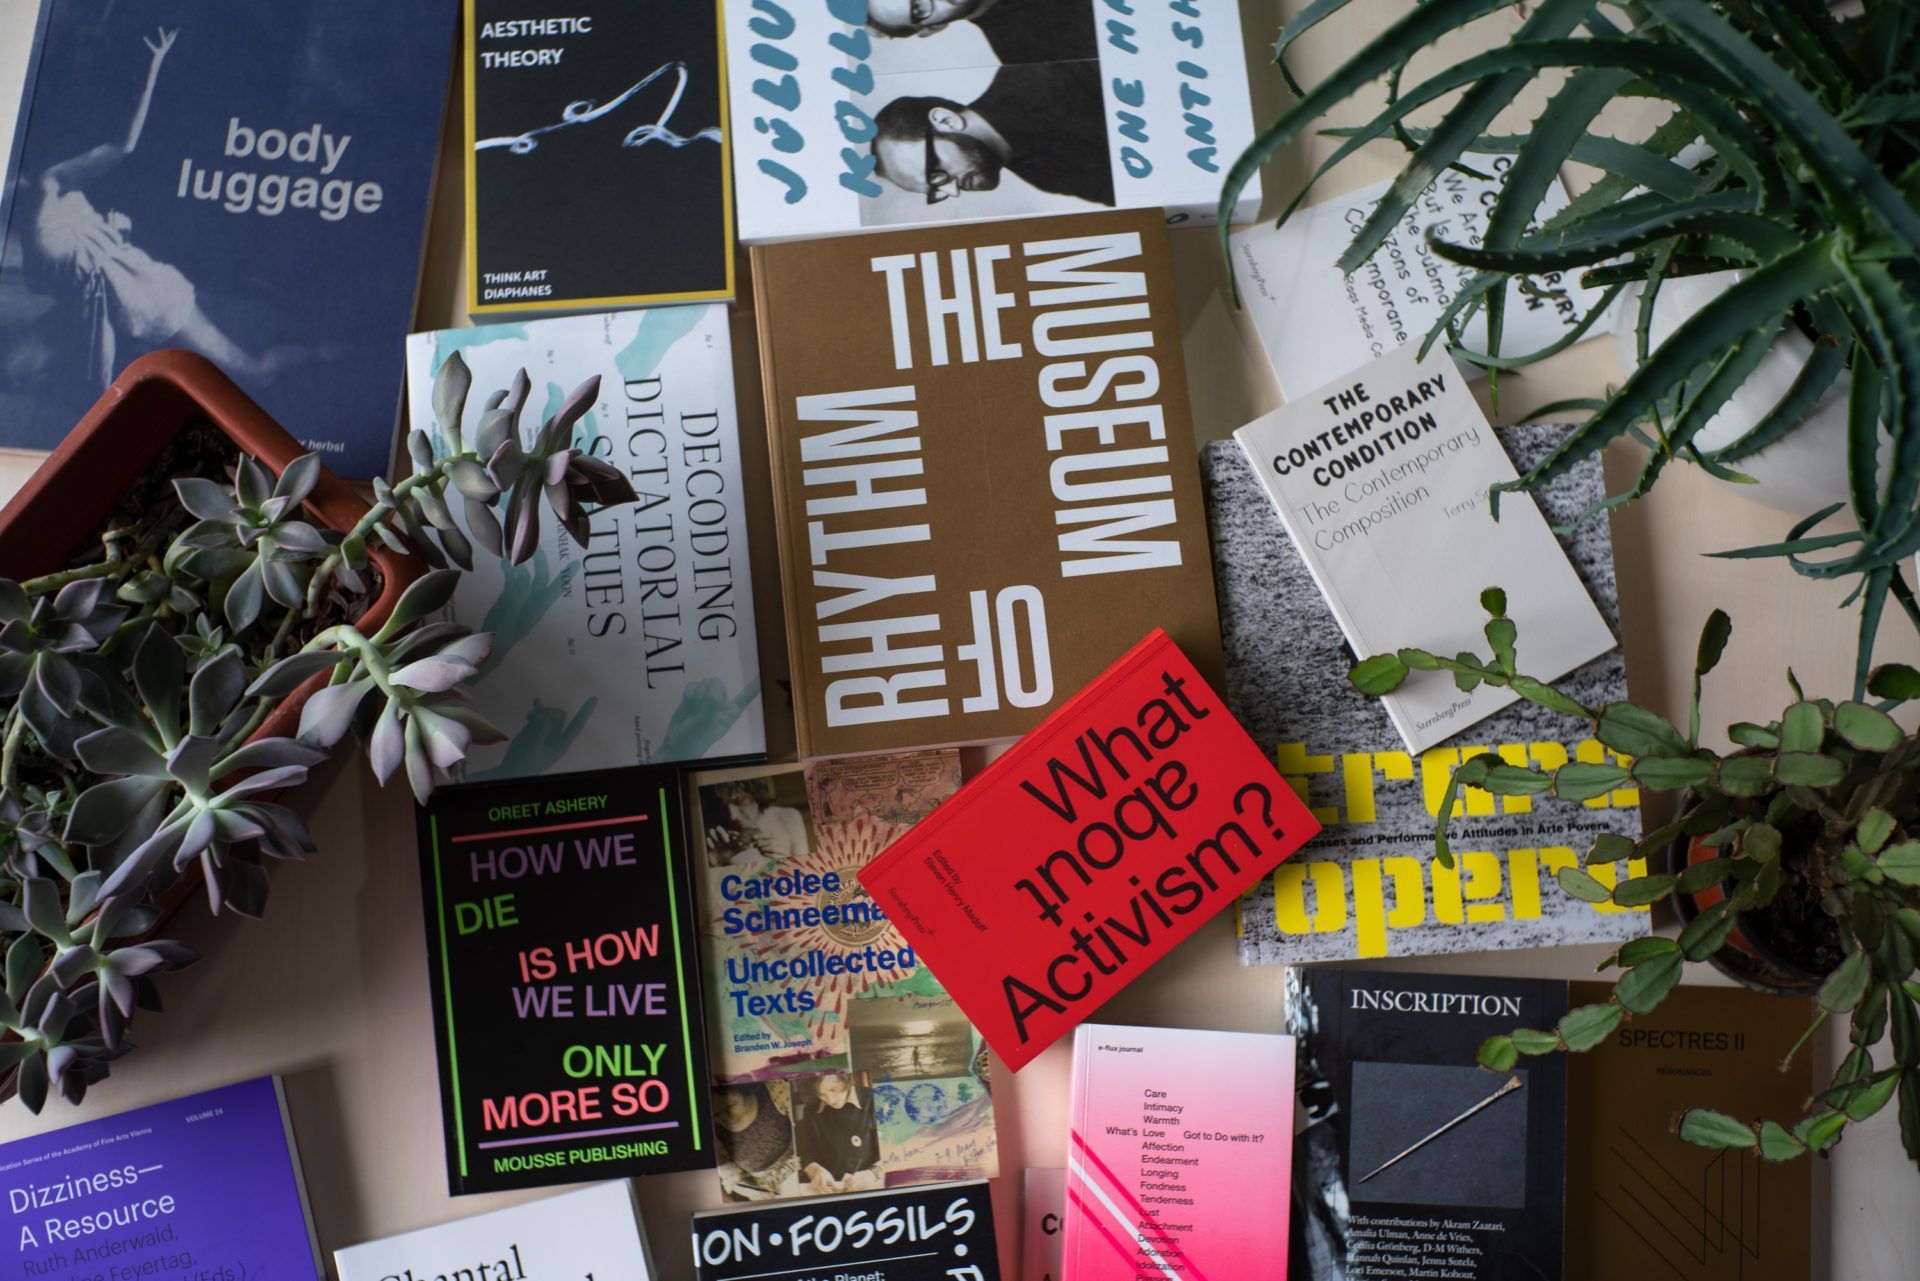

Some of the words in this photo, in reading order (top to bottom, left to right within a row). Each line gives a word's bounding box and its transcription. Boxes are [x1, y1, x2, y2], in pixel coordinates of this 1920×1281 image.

[480, 16, 592, 39] AESTHETIC
[481, 48, 564, 68] THEORY
[1112, 77, 1153, 179] ONE
[1176, 60, 1220, 173] ANTI
[224, 117, 352, 174] body
[177, 159, 384, 220] luggage
[1443, 172, 1467, 205] We
[1459, 212, 1481, 246] Are
[483, 271, 521, 284] THINK
[523, 269, 548, 282] ART
[483, 285, 553, 299] DIAPHANES
[871, 244, 1023, 369] THE
[1406, 287, 1429, 305] of
[1356, 306, 1375, 339] Media
[1022, 232, 1182, 577] MUSEUM
[1324, 382, 1371, 416] THE
[1272, 373, 1449, 477] CONTEMPORARY
[1312, 412, 1439, 487] CONDITION
[1300, 500, 1341, 526] The
[1344, 424, 1481, 504] Contemporary
[679, 407, 737, 643] DECODING
[1314, 485, 1430, 551] Composition
[1441, 498, 1476, 520] Terry
[574, 434, 627, 638] STUES
[624, 373, 685, 690] DICTATORIAL
[796, 385, 949, 727] RHYTHM
[560, 567, 573, 598] YOON
[957, 585, 1054, 713] OF
[1019, 670, 1210, 825] What
[488, 802, 542, 822] OREET
[545, 795, 608, 815] ASHERY
[1014, 759, 1199, 929] about
[1350, 835, 1374, 846] and
[1377, 830, 1458, 846] Performave
[1461, 826, 1518, 840] Attitudes
[1521, 826, 1533, 836] in
[1538, 822, 1564, 834] Arte
[1567, 820, 1610, 833] Povera
[470, 841, 564, 883] HOW
[574, 833, 637, 871] WE
[933, 849, 955, 875] Edited
[951, 873, 963, 885] by
[720, 868, 840, 902] Carolee
[924, 857, 947, 884] Steven
[945, 882, 965, 907] Henry
[963, 905, 988, 932] Madoff
[454, 893, 520, 936] DIE
[722, 902, 888, 935] Schneema
[1001, 781, 1285, 1045] Activism?
[518, 946, 558, 983] IS
[566, 923, 659, 974] HOW
[727, 944, 916, 985] Uncollected
[512, 985, 574, 1018] WE
[586, 983, 667, 1017] LIVE
[731, 985, 815, 1018] Texts
[1351, 988, 1522, 1017] INSCRIPTION
[733, 1032, 760, 1042] Edited
[761, 1032, 772, 1040] by
[734, 1043, 770, 1053] Branden
[770, 1041, 783, 1049] W.
[784, 1038, 813, 1049] Joseph
[1098, 1044, 1118, 1052] e-flux
[1118, 1045, 1144, 1054] journal
[1619, 1029, 1729, 1051] SPECTRES
[562, 1044, 667, 1078] ONLY
[1656, 1066, 1713, 1077] RESONANCES
[482, 1086, 602, 1131] MORE
[611, 1080, 670, 1116] SO
[1144, 1089, 1167, 1099] Care
[1144, 1102, 1184, 1114] Intimacy
[185, 1111, 214, 1124] VOLUME
[214, 1107, 224, 1117] 24
[1143, 1116, 1180, 1126] Warmth
[22, 1156, 43, 1166] Series
[43, 1153, 51, 1161] of
[51, 1150, 62, 1159] the
[62, 1143, 92, 1157] Academy
[93, 1140, 101, 1148] of
[101, 1136, 115, 1146] Fine
[115, 1132, 130, 1142] Arts
[129, 1127, 152, 1138] Vienna
[1142, 1142, 1185, 1152] Affection
[1143, 1129, 1166, 1139] Love
[1183, 1130, 1201, 1141] Got
[1203, 1132, 1213, 1141] to
[1215, 1133, 1229, 1142] Do
[1230, 1133, 1250, 1143] with
[1252, 1134, 1265, 1143] It?
[494, 1151, 567, 1173] MOUSSE
[569, 1140, 669, 1164] PUBLISHING
[1141, 1155, 1199, 1166] Endearment
[1140, 1181, 1187, 1192] Fondness
[1141, 1168, 1179, 1180] Longing
[1138, 1208, 1160, 1217] Lust
[1139, 1194, 1194, 1206] Tenderness
[19, 1226, 39, 1252] A
[44, 1194, 176, 1244] Resource
[788, 1198, 976, 1256] FOSSILS
[1137, 1233, 1180, 1244] Devotion
[1138, 1221, 1193, 1232] Attachment
[1347, 1215, 1369, 1225] With
[1370, 1217, 1428, 1227] contributions
[1429, 1218, 1440, 1230] by
[1442, 1219, 1471, 1229] Akram
[1347, 1228, 1377, 1238] Amalia
[1412, 1231, 1435, 1240] Anne
[1436, 1231, 1448, 1240] de
[23, 1252, 67, 1278] Ruth
[73, 1223, 179, 1264] Anderwald,
[109, 1250, 197, 1281] Feyertag,
[1136, 1247, 1184, 1258] Adoration
[1422, 1256, 1446, 1266] Jenna
[1409, 1268, 1438, 1277] Martin
